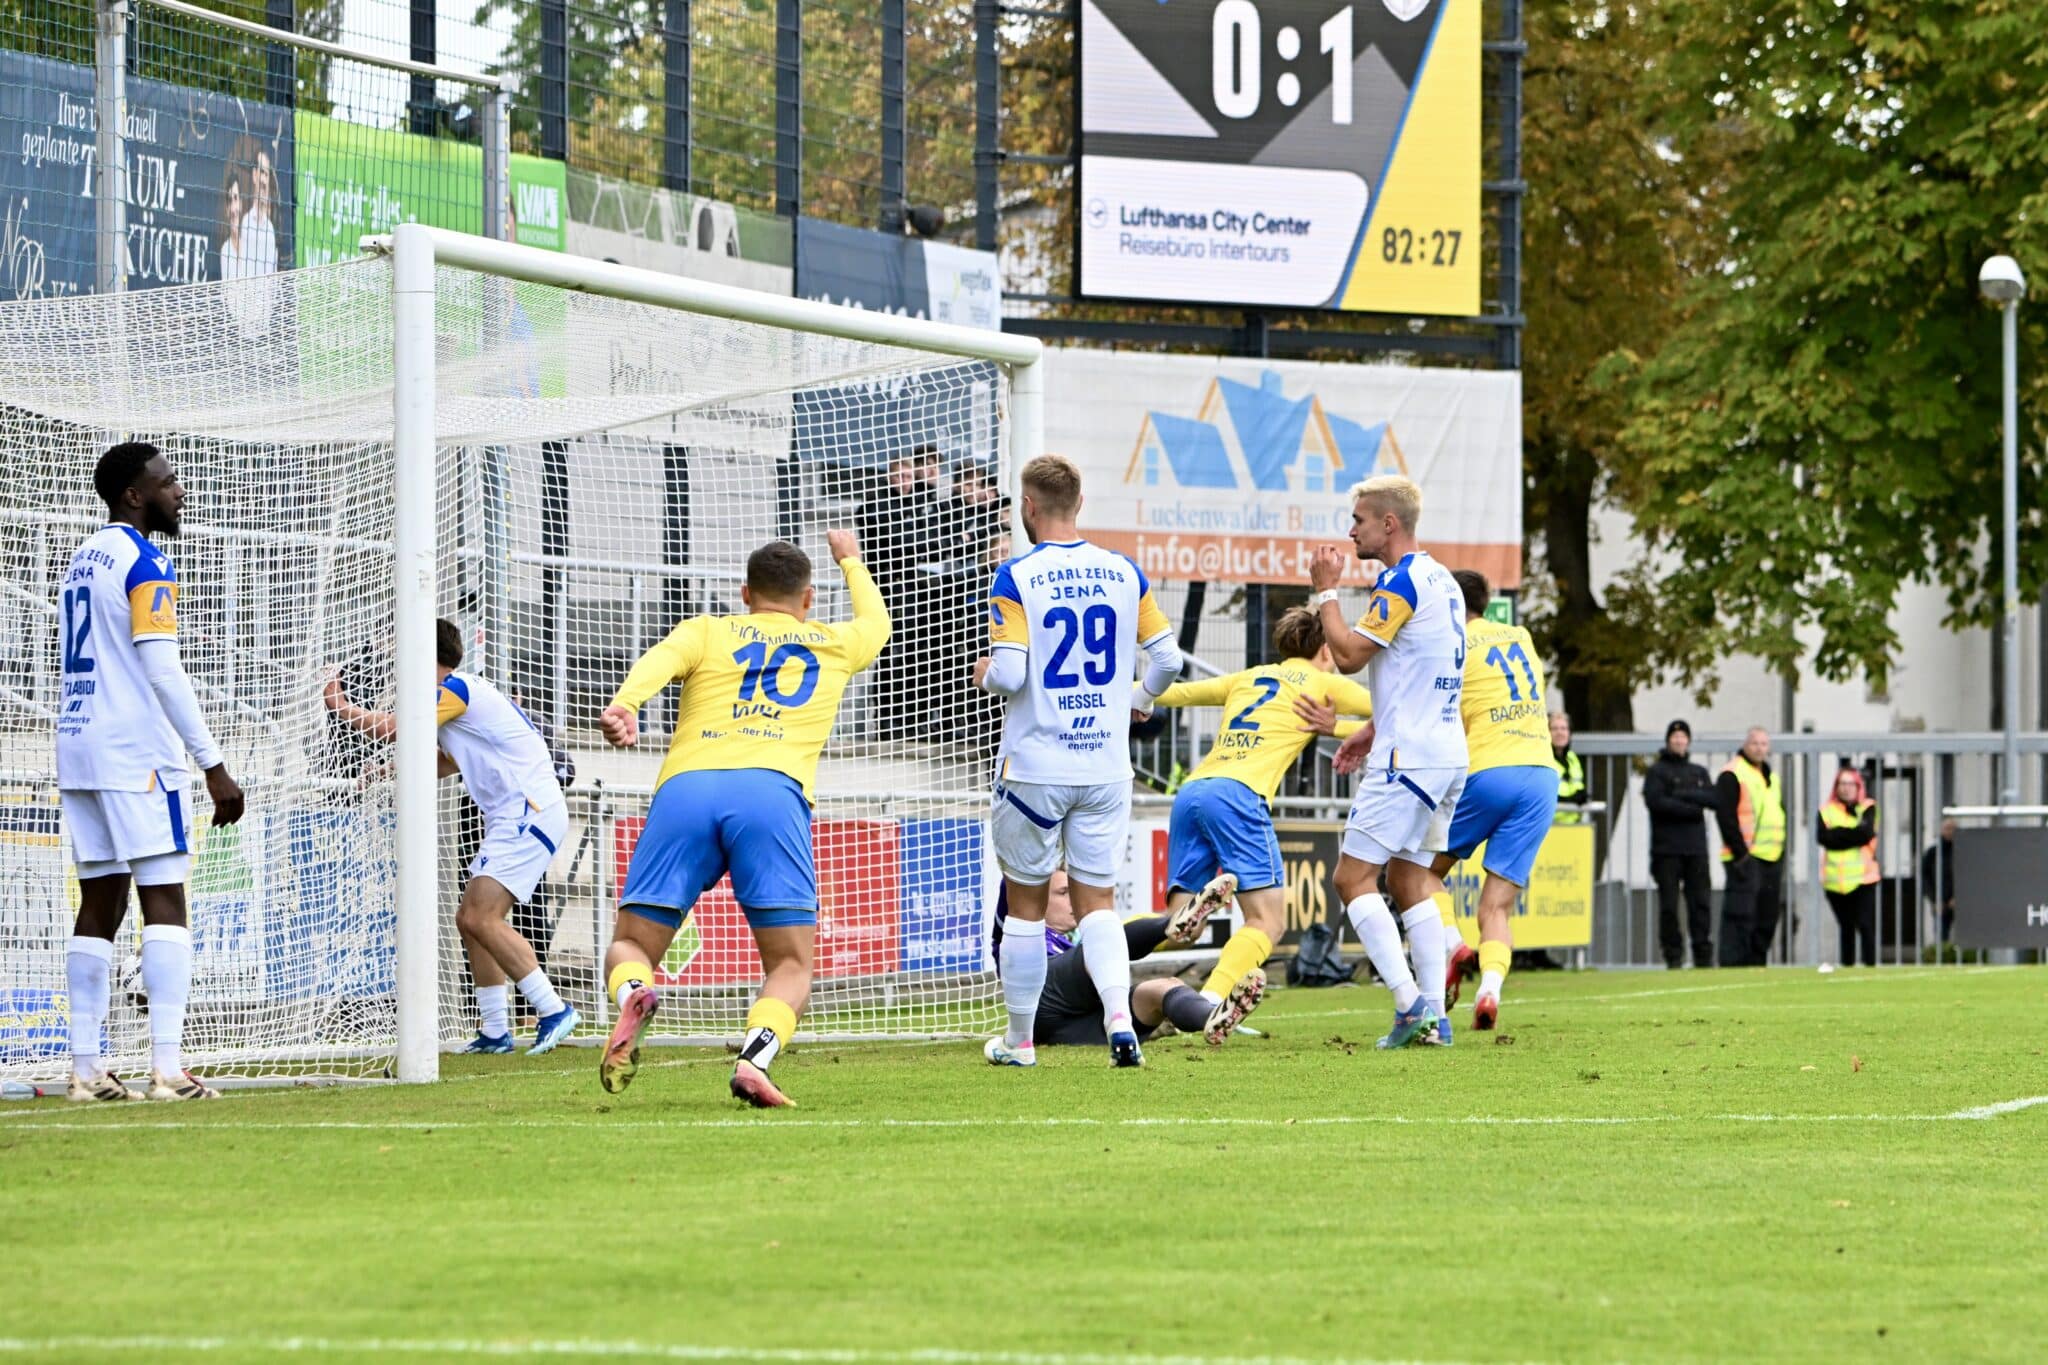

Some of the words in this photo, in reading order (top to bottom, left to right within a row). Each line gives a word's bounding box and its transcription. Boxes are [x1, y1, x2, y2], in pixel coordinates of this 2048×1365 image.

[1213, 0, 1353, 125] 0:1
[58, 92, 86, 128] Ihre
[90, 98, 157, 143] iduell
[22, 126, 79, 168] geplante
[1119, 205, 1208, 230] Lufthansa
[1212, 210, 1248, 236] City
[1252, 212, 1312, 236] Center
[1119, 231, 1206, 258] Reisebüro
[1209, 237, 1291, 263] Intertours
[1382, 227, 1462, 267] 82:27
[1135, 499, 1282, 533] Luckenwalder
[1287, 505, 1328, 533] Bau
[65, 566, 95, 585] JENA
[87, 549, 116, 571] ZEISS
[1030, 575, 1045, 589] FC
[1048, 568, 1082, 584] CARL
[1085, 568, 1125, 583] ZEISS
[1050, 585, 1107, 600] JENA
[64, 586, 95, 674] 12
[1043, 604, 1117, 689] 29
[732, 641, 821, 708] 10
[1485, 641, 1540, 702] 11
[1058, 693, 1106, 710] HESSEL
[1228, 676, 1281, 731] 2
[1058, 730, 1112, 742] stadtwerke
[1067, 741, 1104, 752] energie
